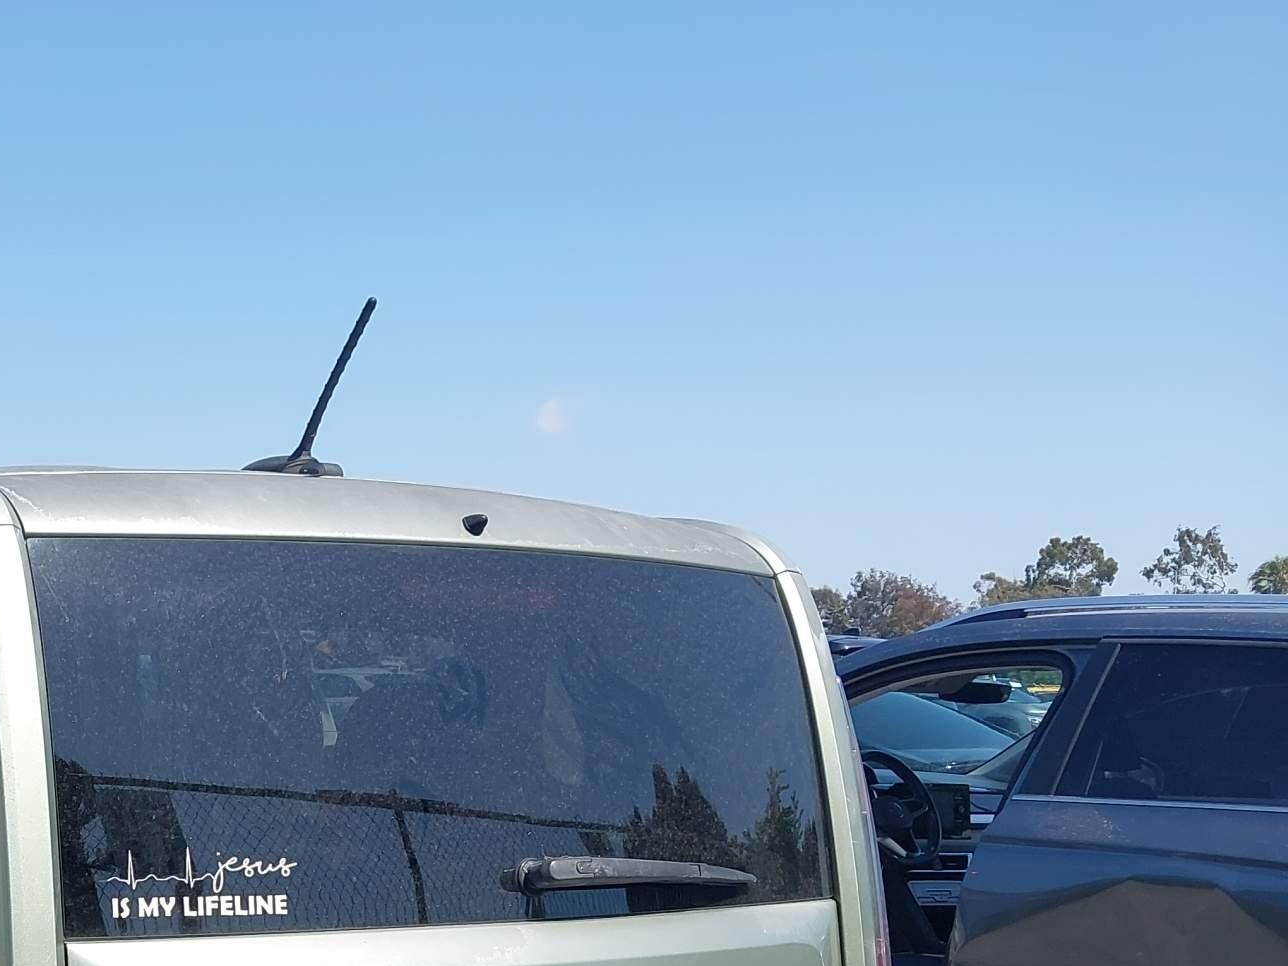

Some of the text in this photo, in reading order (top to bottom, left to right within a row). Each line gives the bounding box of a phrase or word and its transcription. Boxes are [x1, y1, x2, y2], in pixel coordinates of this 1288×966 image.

[212, 851, 298, 893] jesus
[112, 894, 289, 919] IS MY LIFELINE
